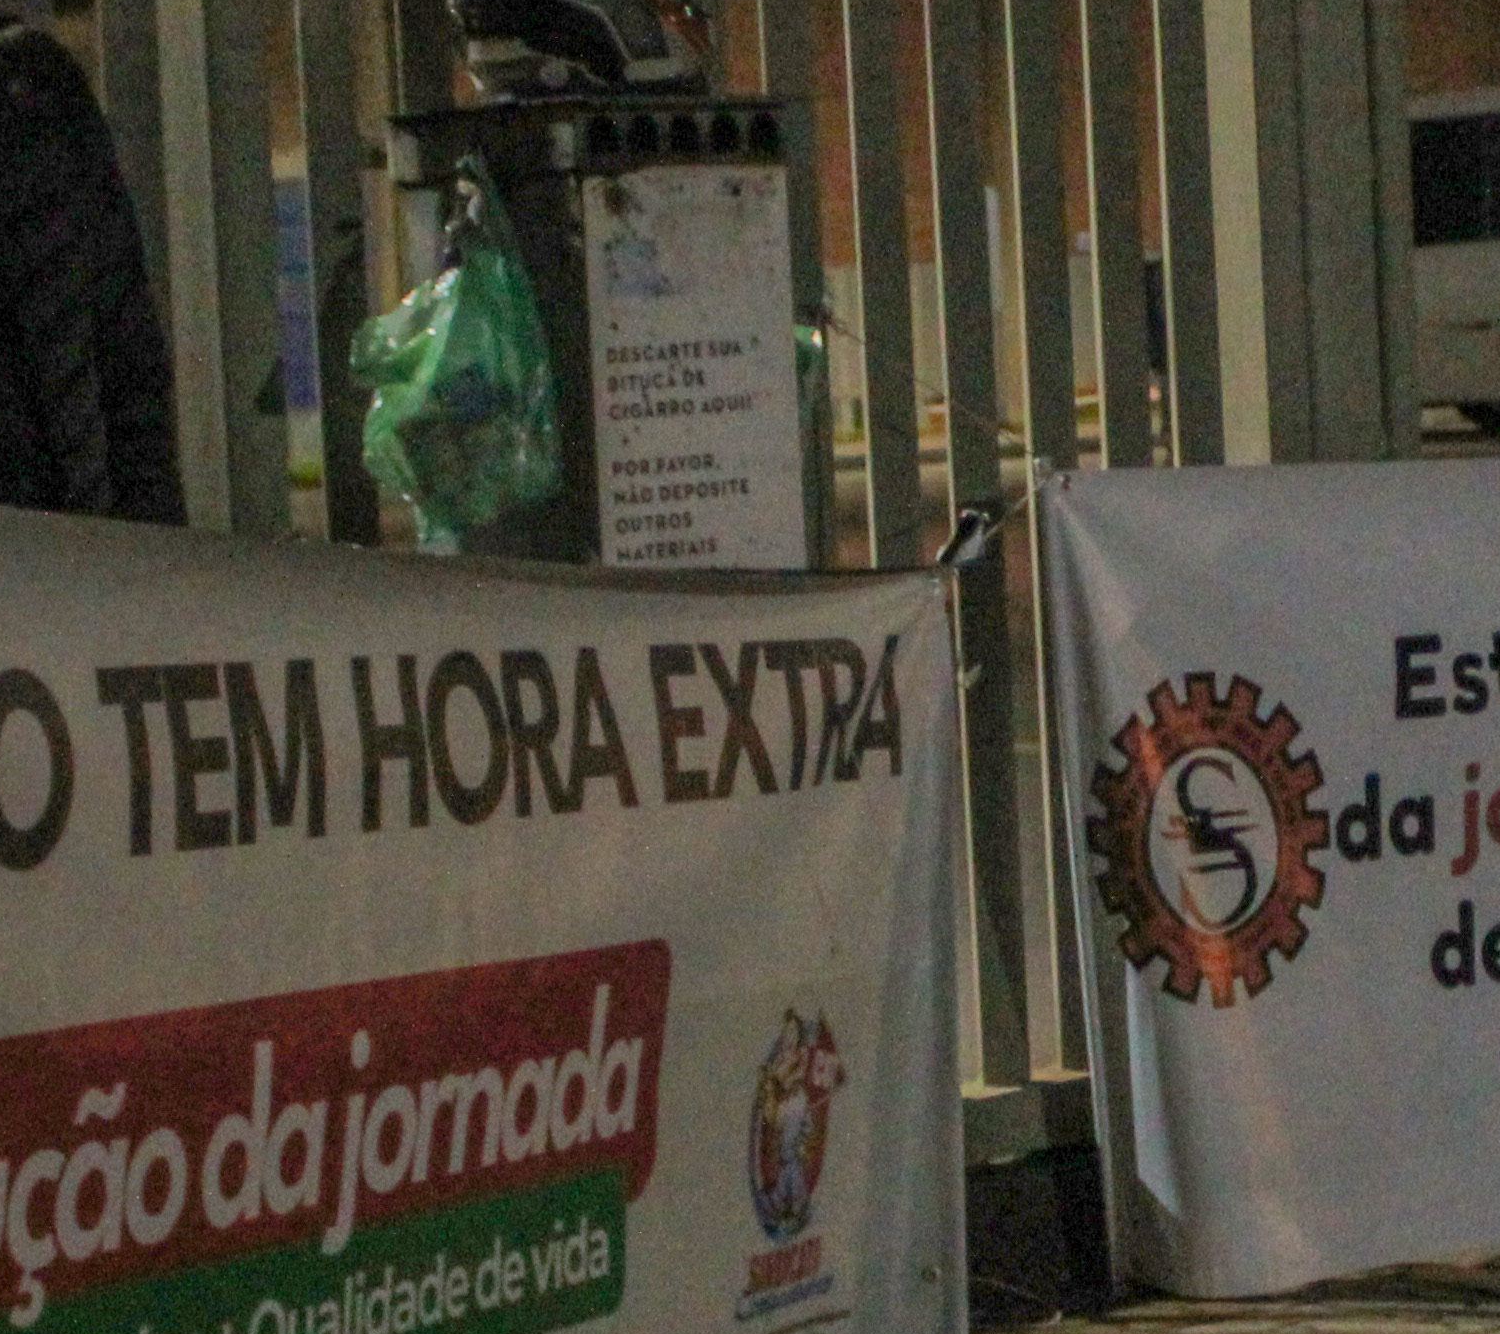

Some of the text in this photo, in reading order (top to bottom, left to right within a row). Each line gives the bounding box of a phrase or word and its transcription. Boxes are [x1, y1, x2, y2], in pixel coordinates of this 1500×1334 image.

[606, 339, 702, 366] DESCARTE
[612, 456, 650, 477] POR
[660, 478, 750, 503] DEPOSITE
[615, 512, 693, 536] OUTROS
[94, 659, 327, 856] TEM
[351, 648, 639, 833] HORA
[648, 635, 903, 805] EXTRA
[1335, 772, 1435, 861] da
[201, 1040, 331, 1220] da
[320, 982, 645, 1256] jornada
[474, 1241, 529, 1312] de
[529, 1215, 611, 1297] vida
